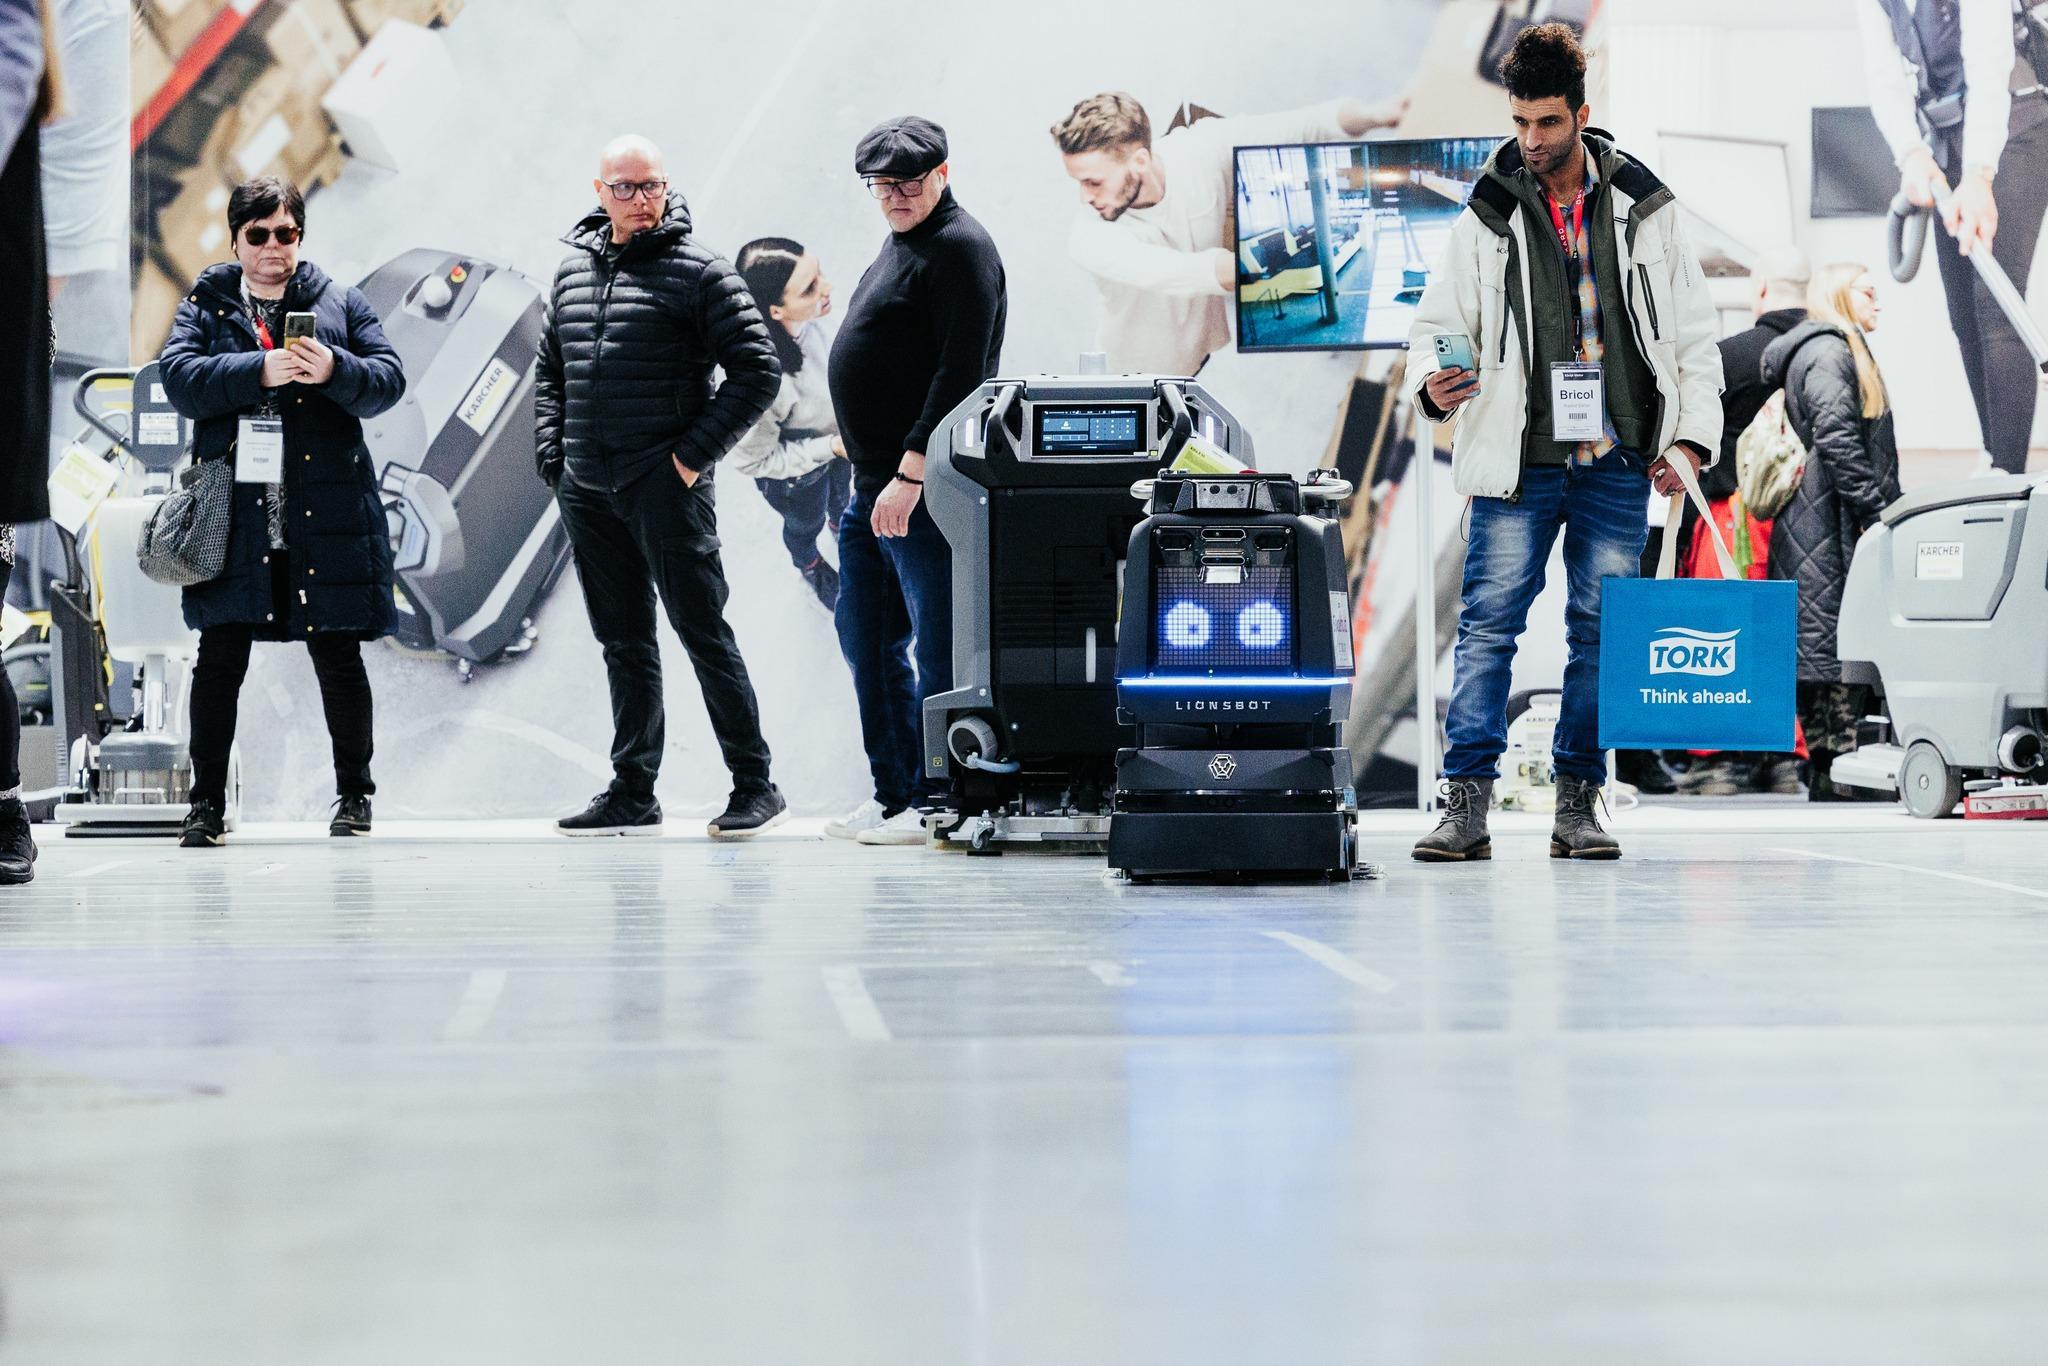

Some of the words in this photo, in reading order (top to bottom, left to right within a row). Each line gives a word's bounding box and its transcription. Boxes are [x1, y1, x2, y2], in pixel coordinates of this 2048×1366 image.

[1560, 389, 1594, 400] Bricol
[1654, 646, 1731, 669] TORK
[1639, 689, 1688, 704] Think
[1691, 688, 1752, 704] ahead.
[1175, 700, 1271, 710] LIONSBOT
